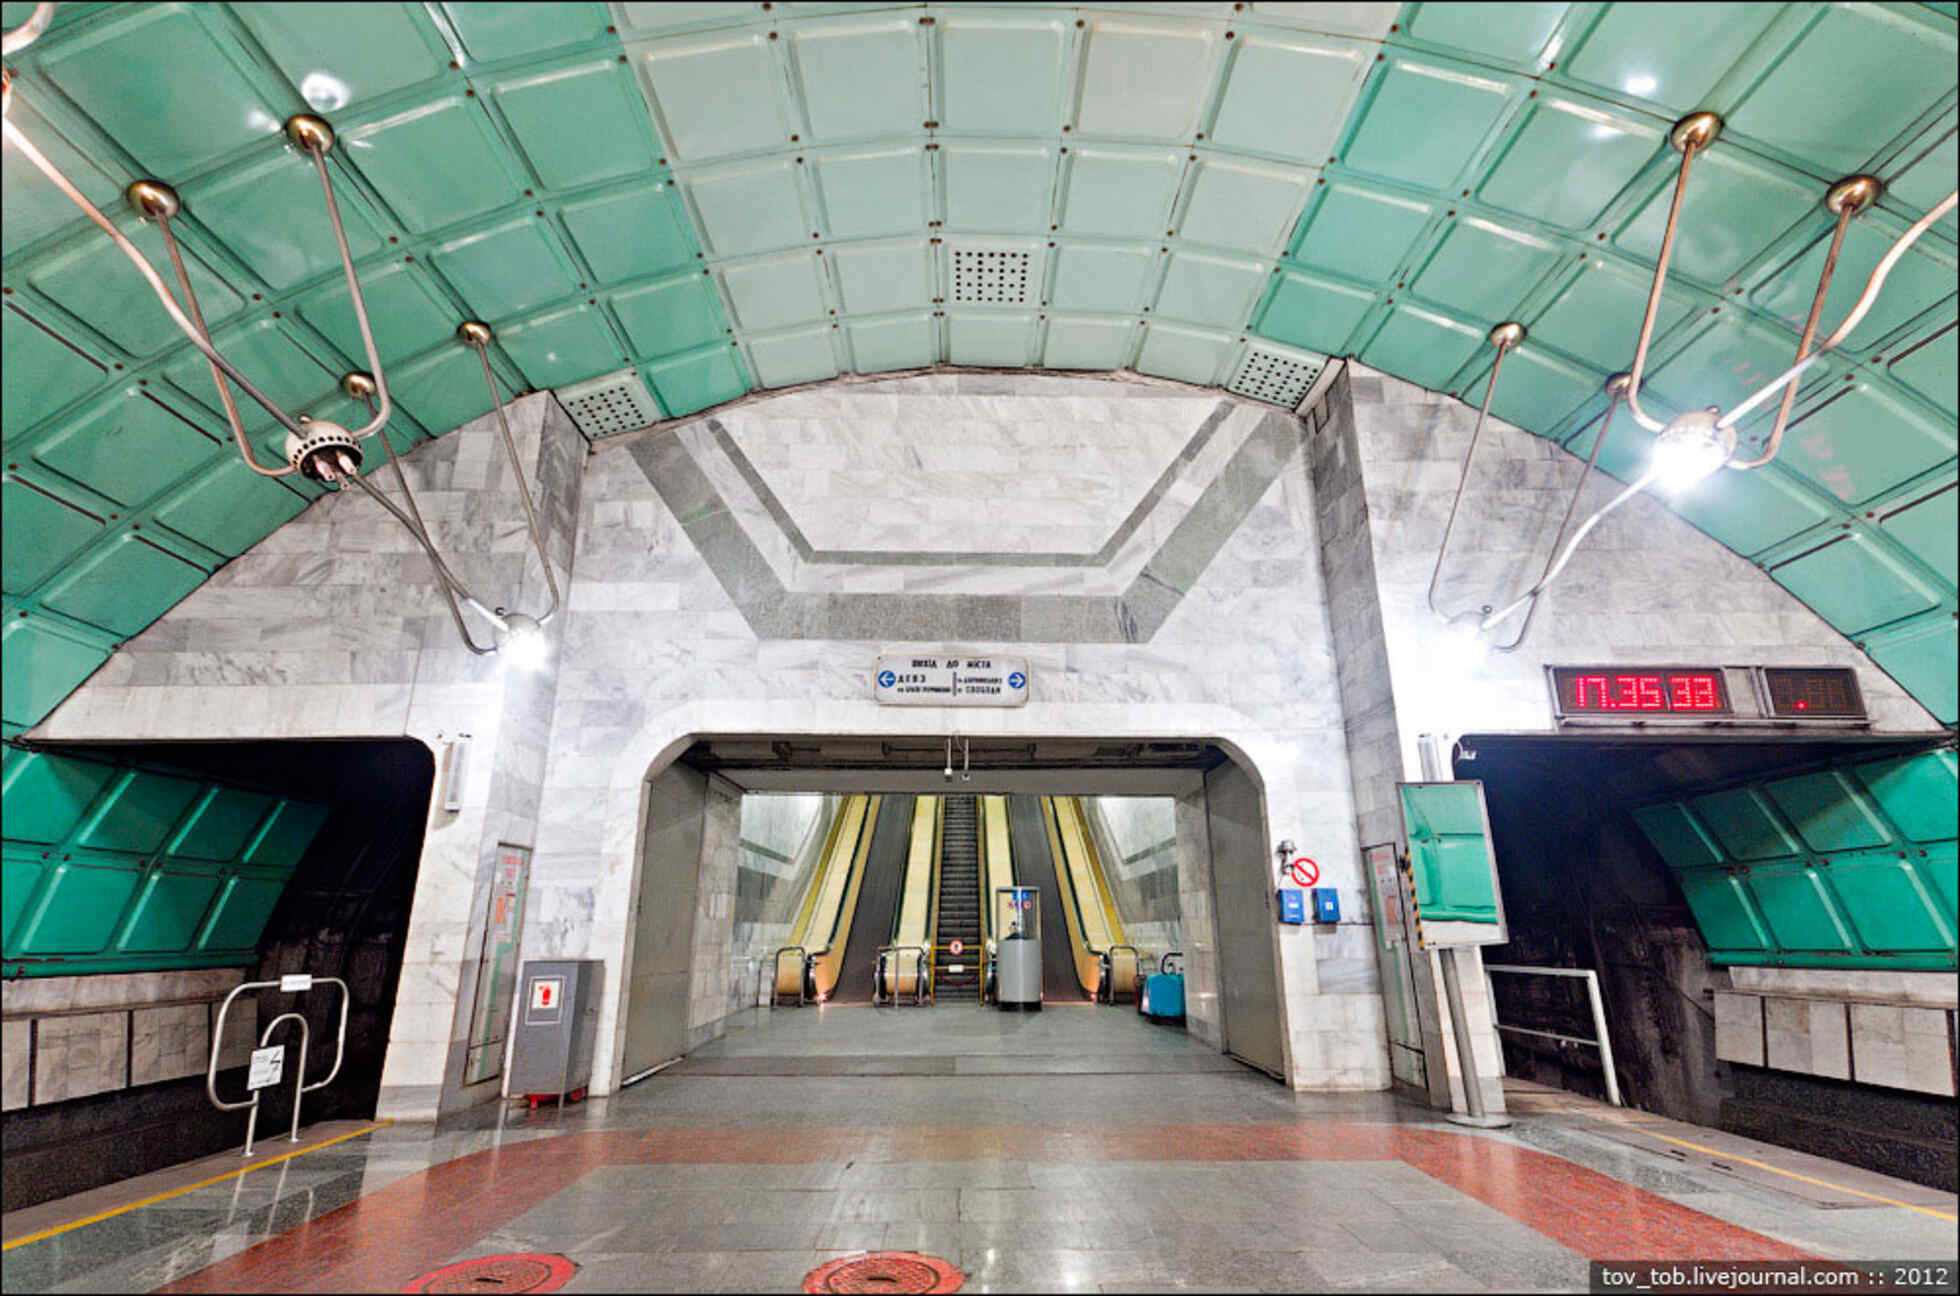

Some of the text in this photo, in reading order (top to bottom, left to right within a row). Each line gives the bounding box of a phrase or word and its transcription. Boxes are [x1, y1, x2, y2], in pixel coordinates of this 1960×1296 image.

[912, 660, 991, 669] ВИХІД ДО МІСТА
